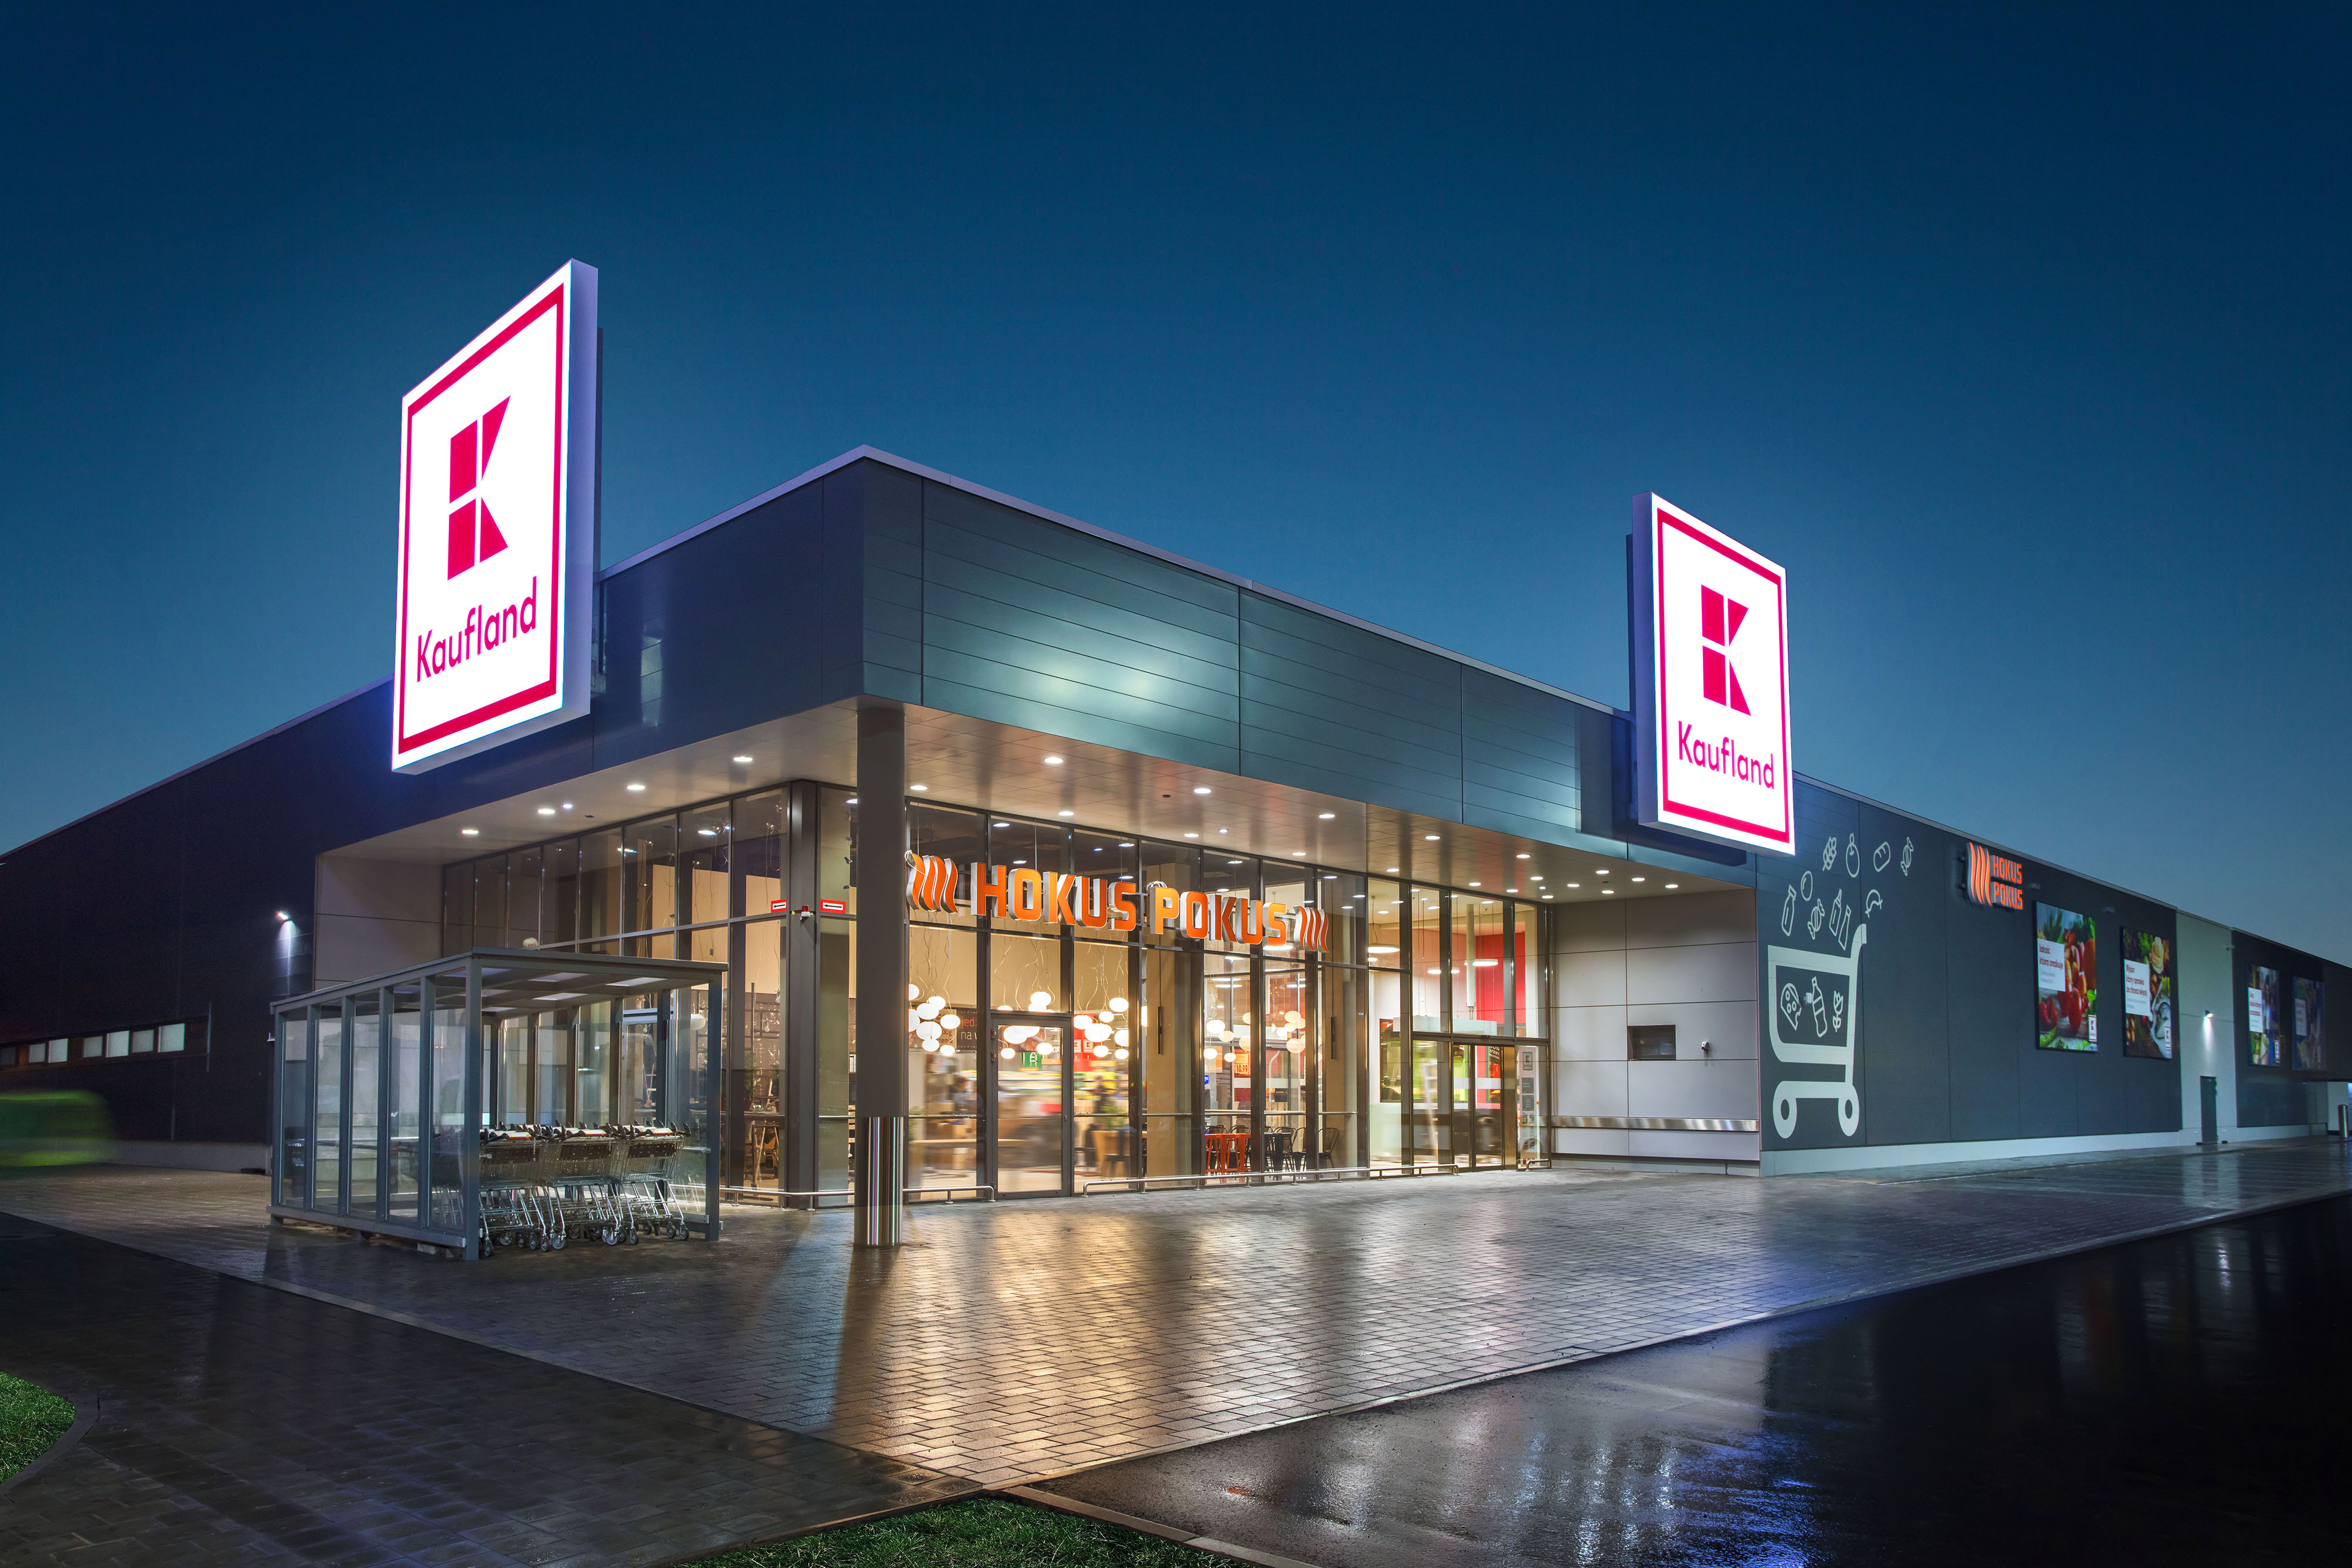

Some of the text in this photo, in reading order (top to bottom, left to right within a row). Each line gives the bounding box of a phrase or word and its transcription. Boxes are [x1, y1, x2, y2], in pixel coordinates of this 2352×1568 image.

[447, 395, 511, 581] K
[417, 576, 537, 683] Kaufland
[1701, 584, 1752, 716] K
[1678, 720, 1775, 790] Kaufland
[1992, 854, 2022, 885] HOKUS
[970, 861, 1288, 947] HOKUS POKUS
[1993, 881, 2023, 910] POKUS
[941, 1029, 953, 1037] 00g
[961, 1031, 972, 1040] na
[1237, 1064, 1248, 1072] 10.99
